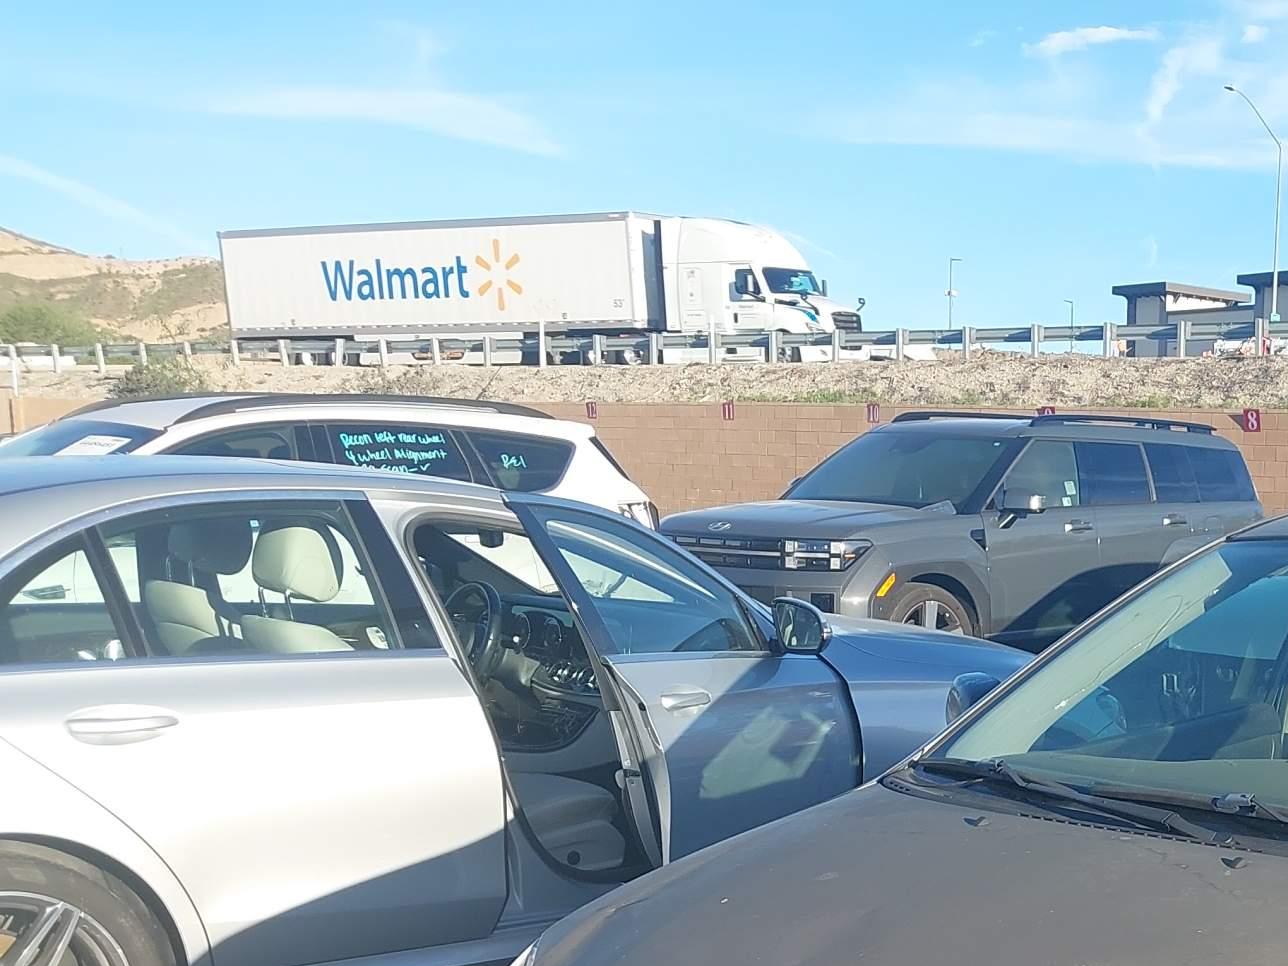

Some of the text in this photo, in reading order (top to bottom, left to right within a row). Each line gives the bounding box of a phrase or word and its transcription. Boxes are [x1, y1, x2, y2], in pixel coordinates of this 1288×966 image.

[320, 255, 470, 302] Walmart
[869, 404, 879, 421] 10
[1247, 410, 1258, 431] 8
[357, 447, 392, 462] wheel
